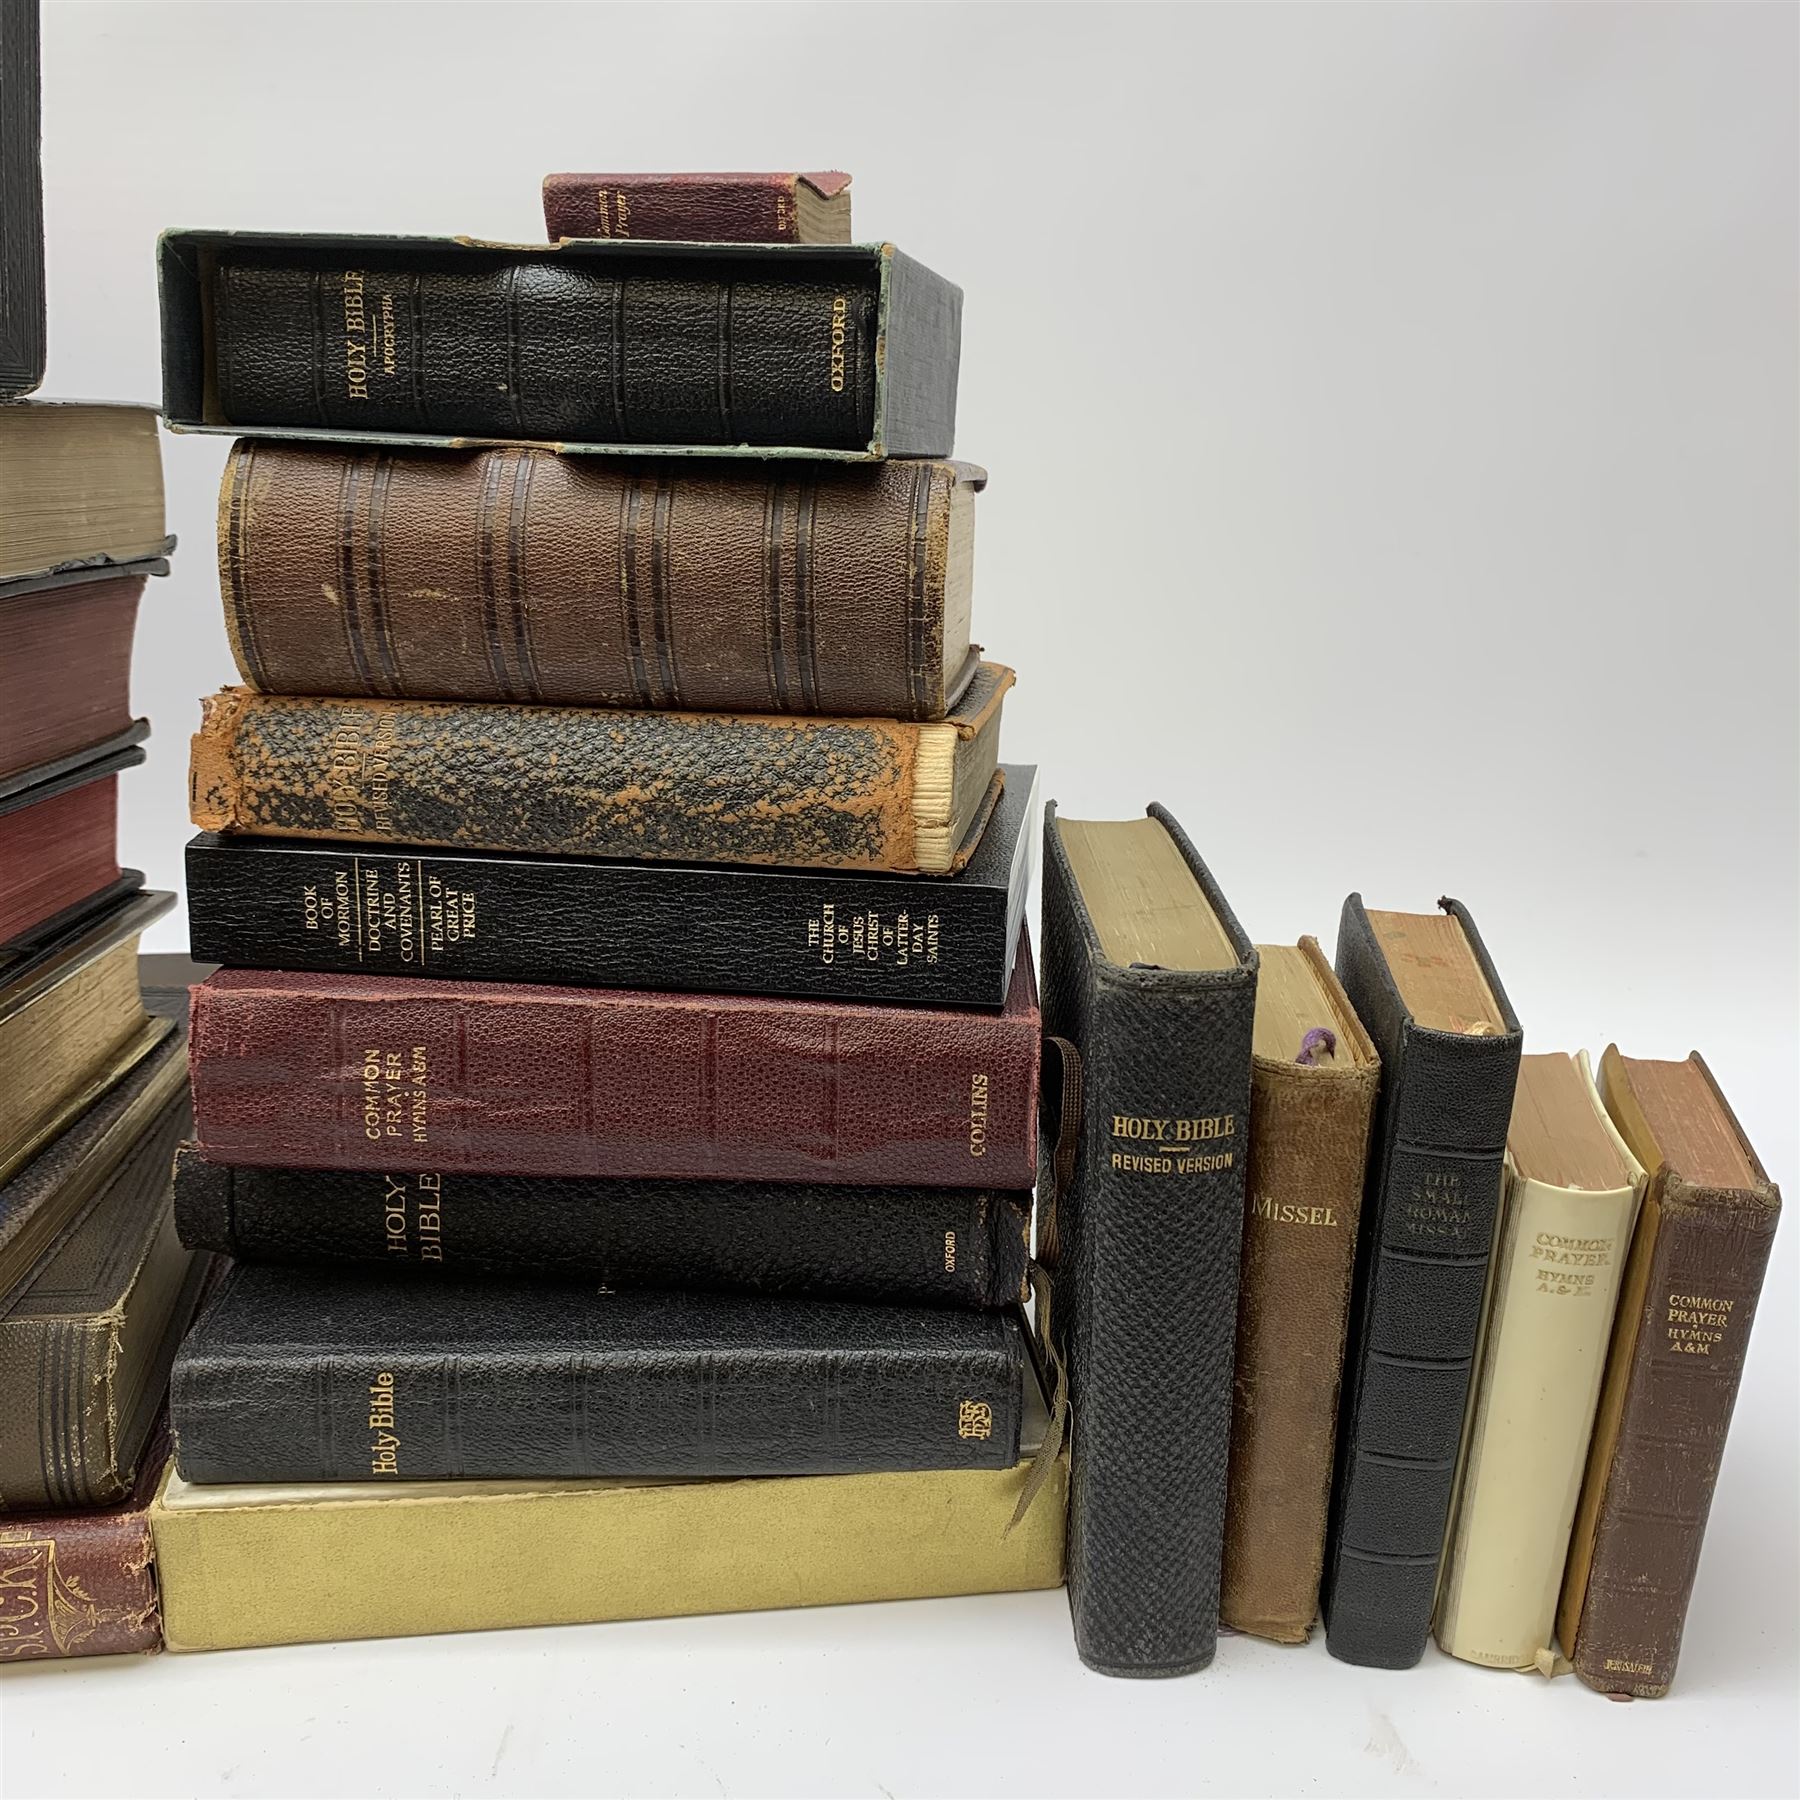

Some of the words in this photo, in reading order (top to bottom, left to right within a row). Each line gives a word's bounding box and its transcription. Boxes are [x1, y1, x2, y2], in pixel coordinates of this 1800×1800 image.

[598, 189, 611, 238] Common
[615, 190, 630, 237] Prayer
[381, 294, 395, 375] APOCRYPHA
[830, 298, 846, 391] OXFORD
[347, 340, 368, 399] HOLY
[373, 711, 396, 768] VERSION
[304, 885, 318, 929] BOOK
[320, 897, 334, 919] OF
[335, 871, 350, 946] MORMON
[366, 869, 381, 951] DOCTRINE
[383, 892, 397, 930] AND
[428, 876, 442, 897] OF
[398, 862, 414, 962] COVENANTS
[430, 901, 444, 951] PEARL
[446, 888, 460, 941] GREAT
[462, 892, 476, 938] PRICE
[808, 919, 820, 946] THE
[823, 903, 835, 963] CHURCH
[838, 924, 849, 943] OF
[852, 916, 865, 954] JESUS
[867, 911, 879, 961] CHRIST
[882, 926, 893, 946] OF
[897, 909, 908, 965] LATTER-
[912, 923, 923, 953] DAY
[927, 914, 939, 963] SAINTS
[363, 1049, 381, 1140] COMMON
[385, 1052, 402, 1136] PRAYER
[412, 1090, 427, 1142] HYMNS
[970, 1073, 988, 1157] COLLINS
[1112, 1116, 1171, 1140] HOLY
[1174, 1114, 1235, 1141] BIBLE
[1112, 1153, 1172, 1173] REVISED
[1177, 1152, 1233, 1174] VERSION
[385, 1175, 407, 1252] HOLY
[419, 1172, 443, 1262] BIBLE
[1252, 1192, 1337, 1227] MISSEL
[945, 1231, 956, 1272] OXFORD
[1536, 1269, 1595, 1286] HYMNS
[1667, 1308, 1728, 1328] PRAYER
[1669, 1294, 1734, 1312] COMMON
[1668, 1328, 1722, 1343] HYMNS
[369, 1372, 394, 1429] Bible
[371, 1430, 401, 1475] Holy
